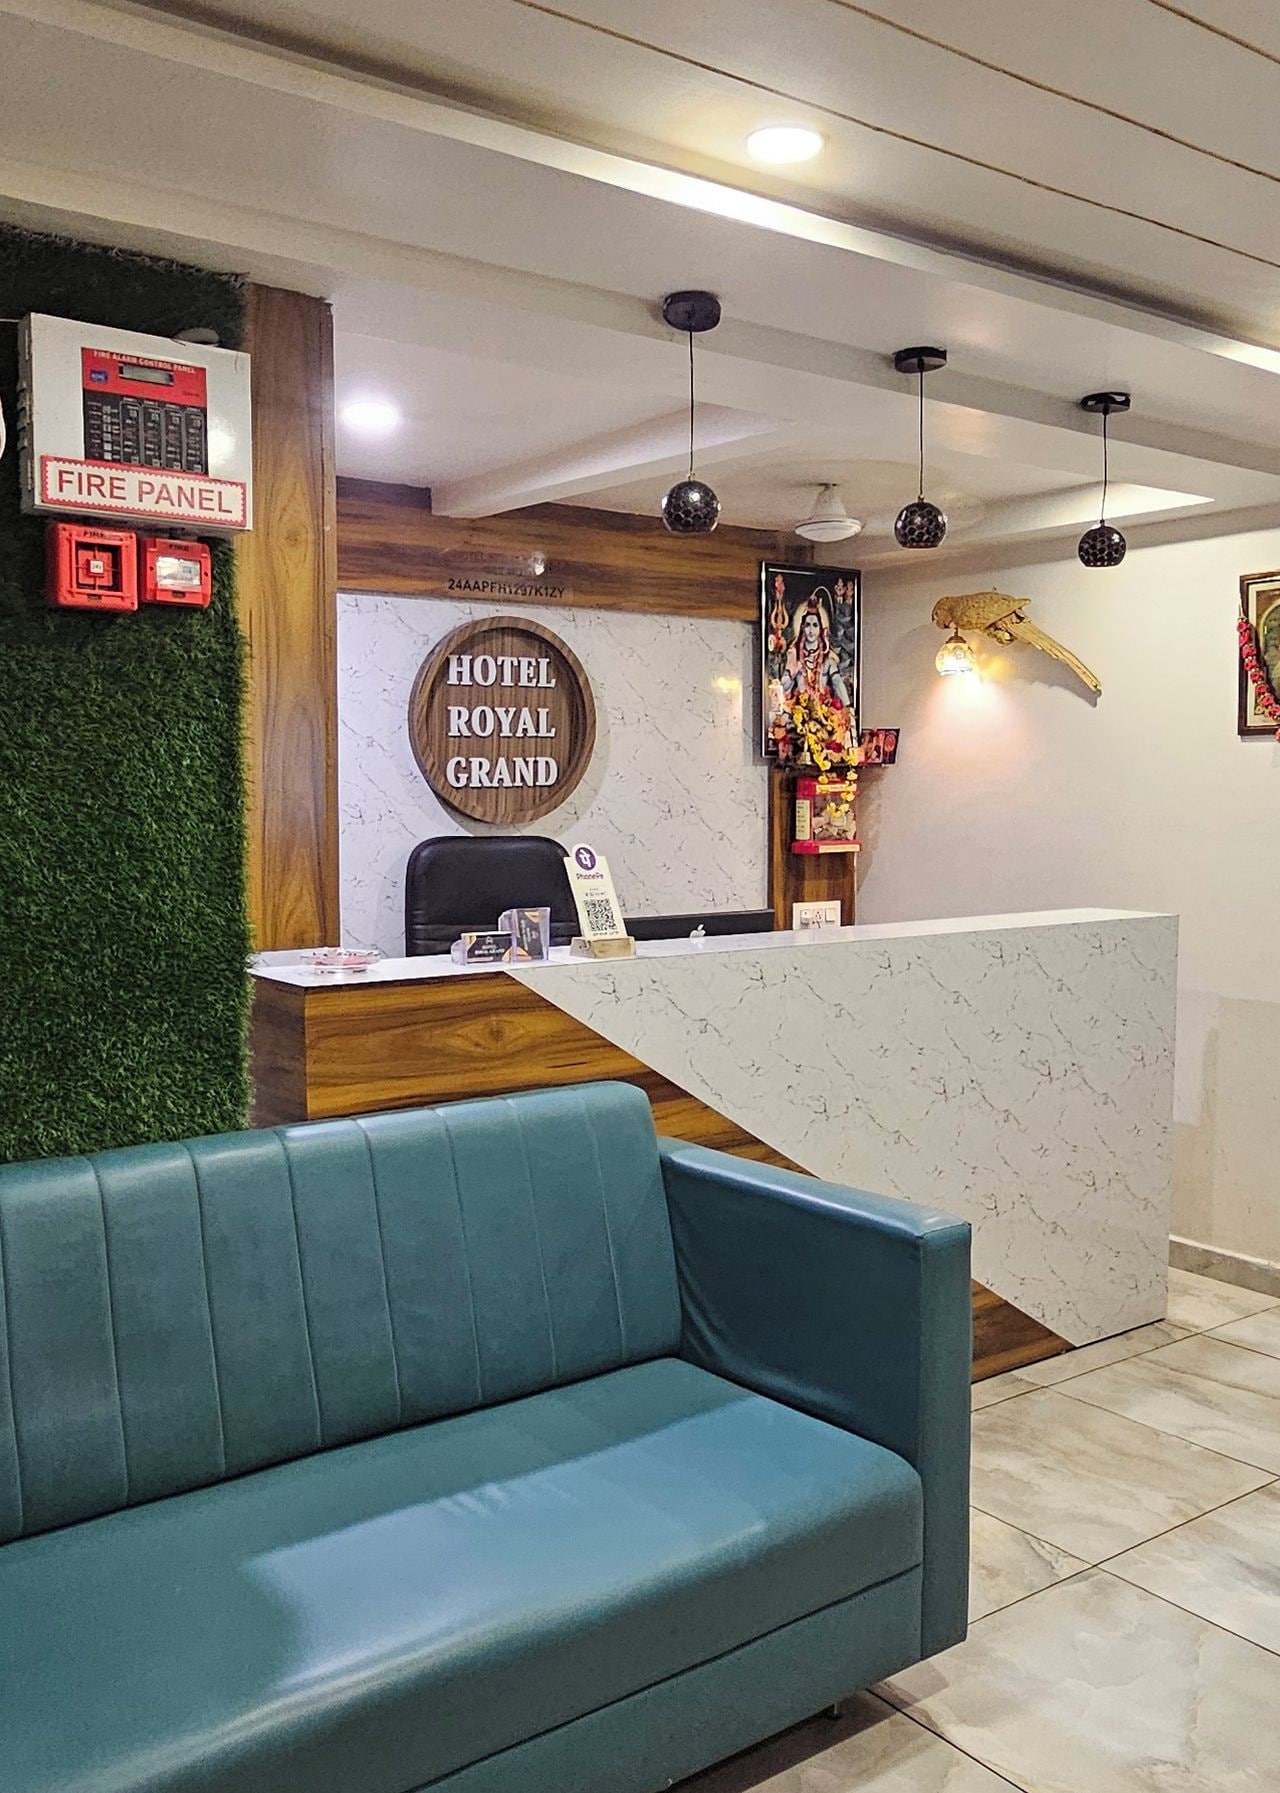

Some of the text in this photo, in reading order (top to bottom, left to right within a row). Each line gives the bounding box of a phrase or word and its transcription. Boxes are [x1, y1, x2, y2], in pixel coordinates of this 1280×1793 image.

[58, 470, 233, 513] FIRE PANEL
[447, 655, 556, 688] HOTEL
[447, 706, 556, 737] ROYAL
[446, 756, 558, 788] GRAND
